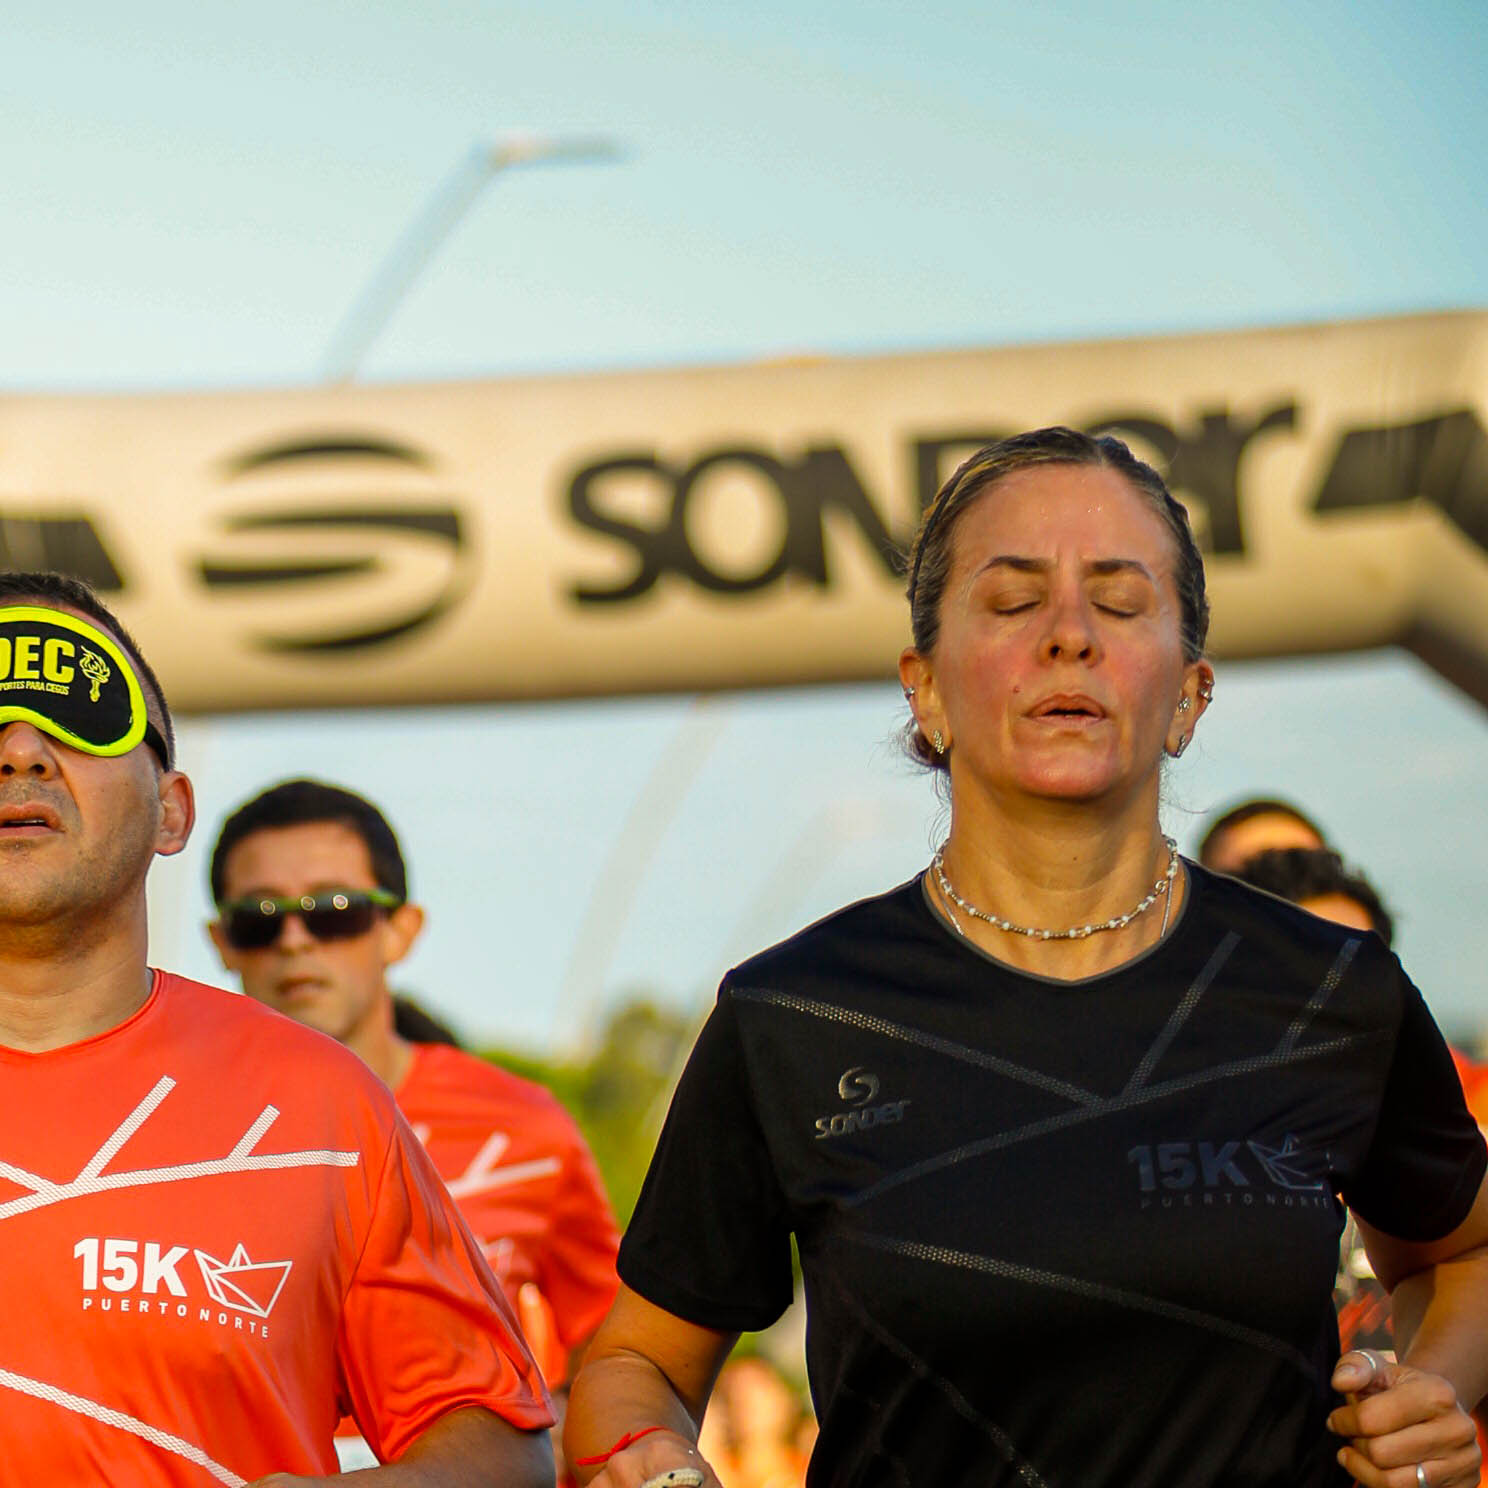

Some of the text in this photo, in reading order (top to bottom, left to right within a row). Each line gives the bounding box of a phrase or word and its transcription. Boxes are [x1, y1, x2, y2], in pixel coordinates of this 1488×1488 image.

[25, 681, 46, 691] PARA
[1127, 1141, 1250, 1191] 15K
[73, 1237, 190, 1297] 15K
[82, 1298, 269, 1338] PUERTO NORTE
